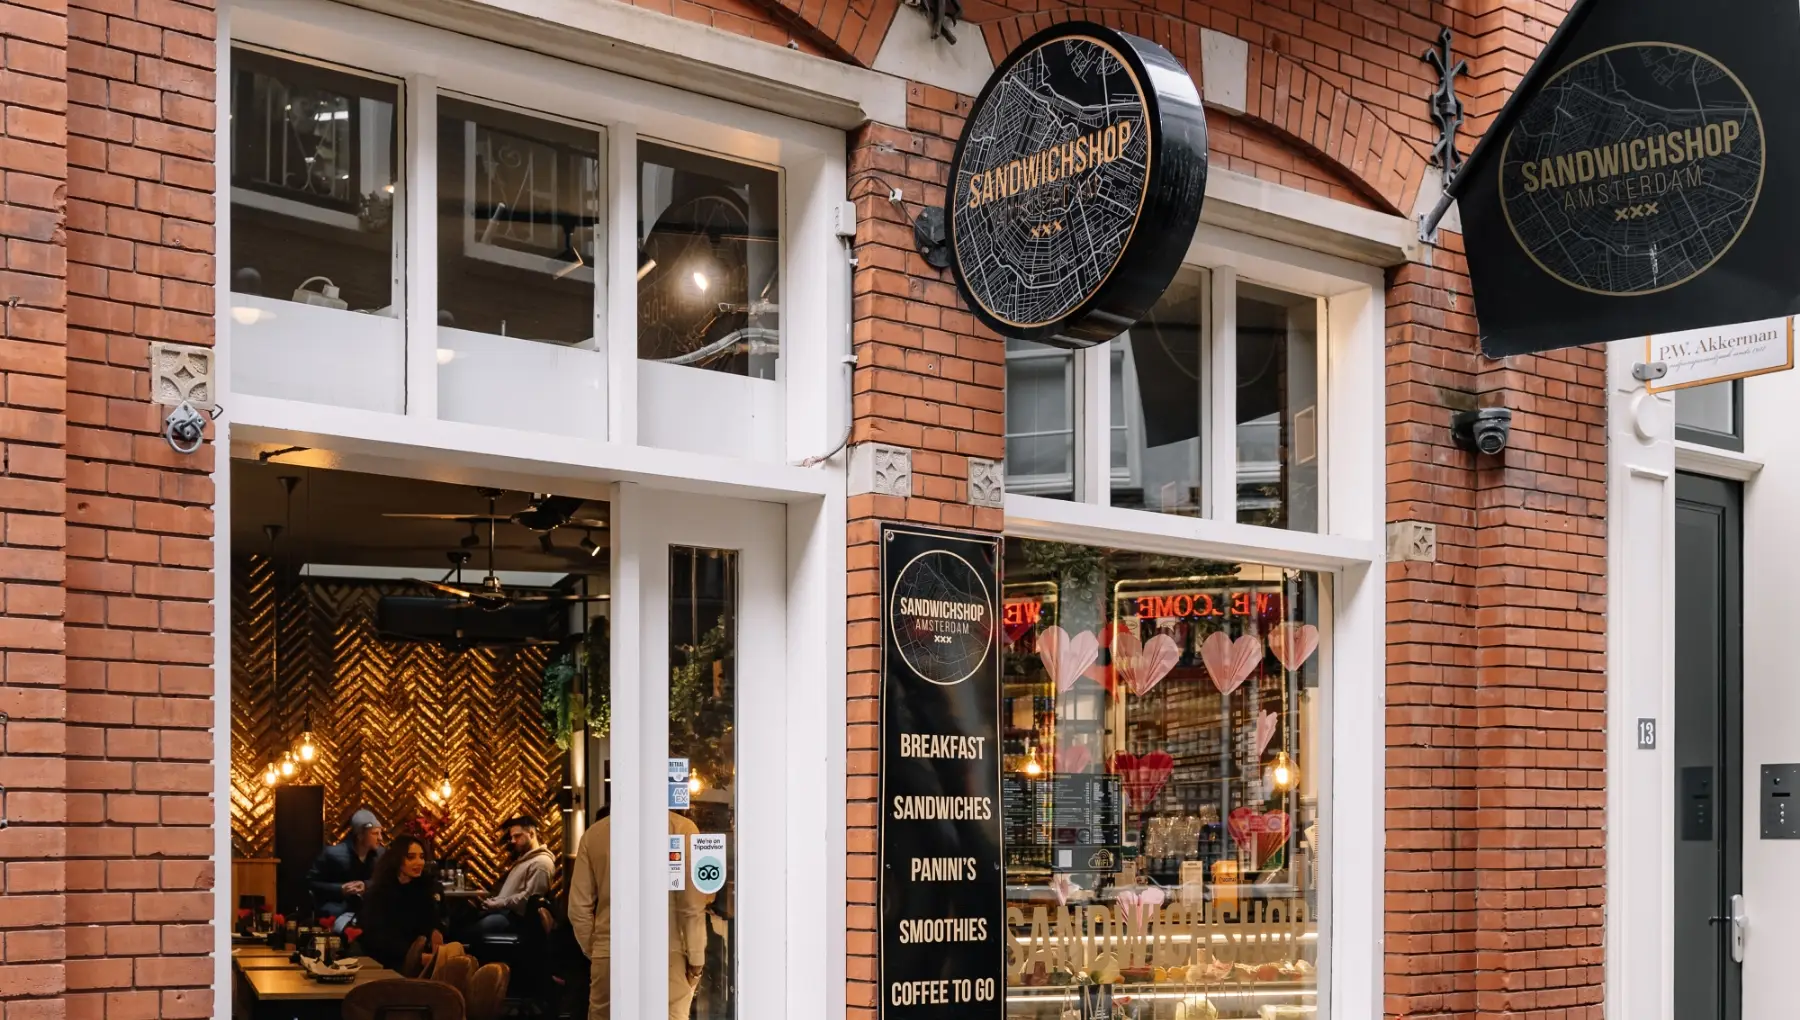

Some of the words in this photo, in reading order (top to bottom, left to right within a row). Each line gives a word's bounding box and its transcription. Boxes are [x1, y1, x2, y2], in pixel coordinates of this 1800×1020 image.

[969, 121, 1131, 209] SANDWICHSHOP
[1521, 120, 1740, 193] SANDWICHSHOP
[1564, 165, 1702, 211] AMSTERDAM
[1659, 341, 1691, 361] P.W.
[1695, 329, 1778, 354] Akkerman
[900, 597, 984, 622] SANDWICHSHOP
[915, 618, 970, 634] AMSTERDAM
[900, 733, 985, 760] BREAKFAST
[1639, 721, 1654, 745] 13
[893, 795, 991, 820] SANDWICHES
[911, 857, 977, 881] PANINI'S
[899, 917, 987, 944] SMOOTHIES
[891, 980, 949, 1006] COFFEE
[952, 979, 972, 1003] TO
[975, 977, 995, 1003] GO
